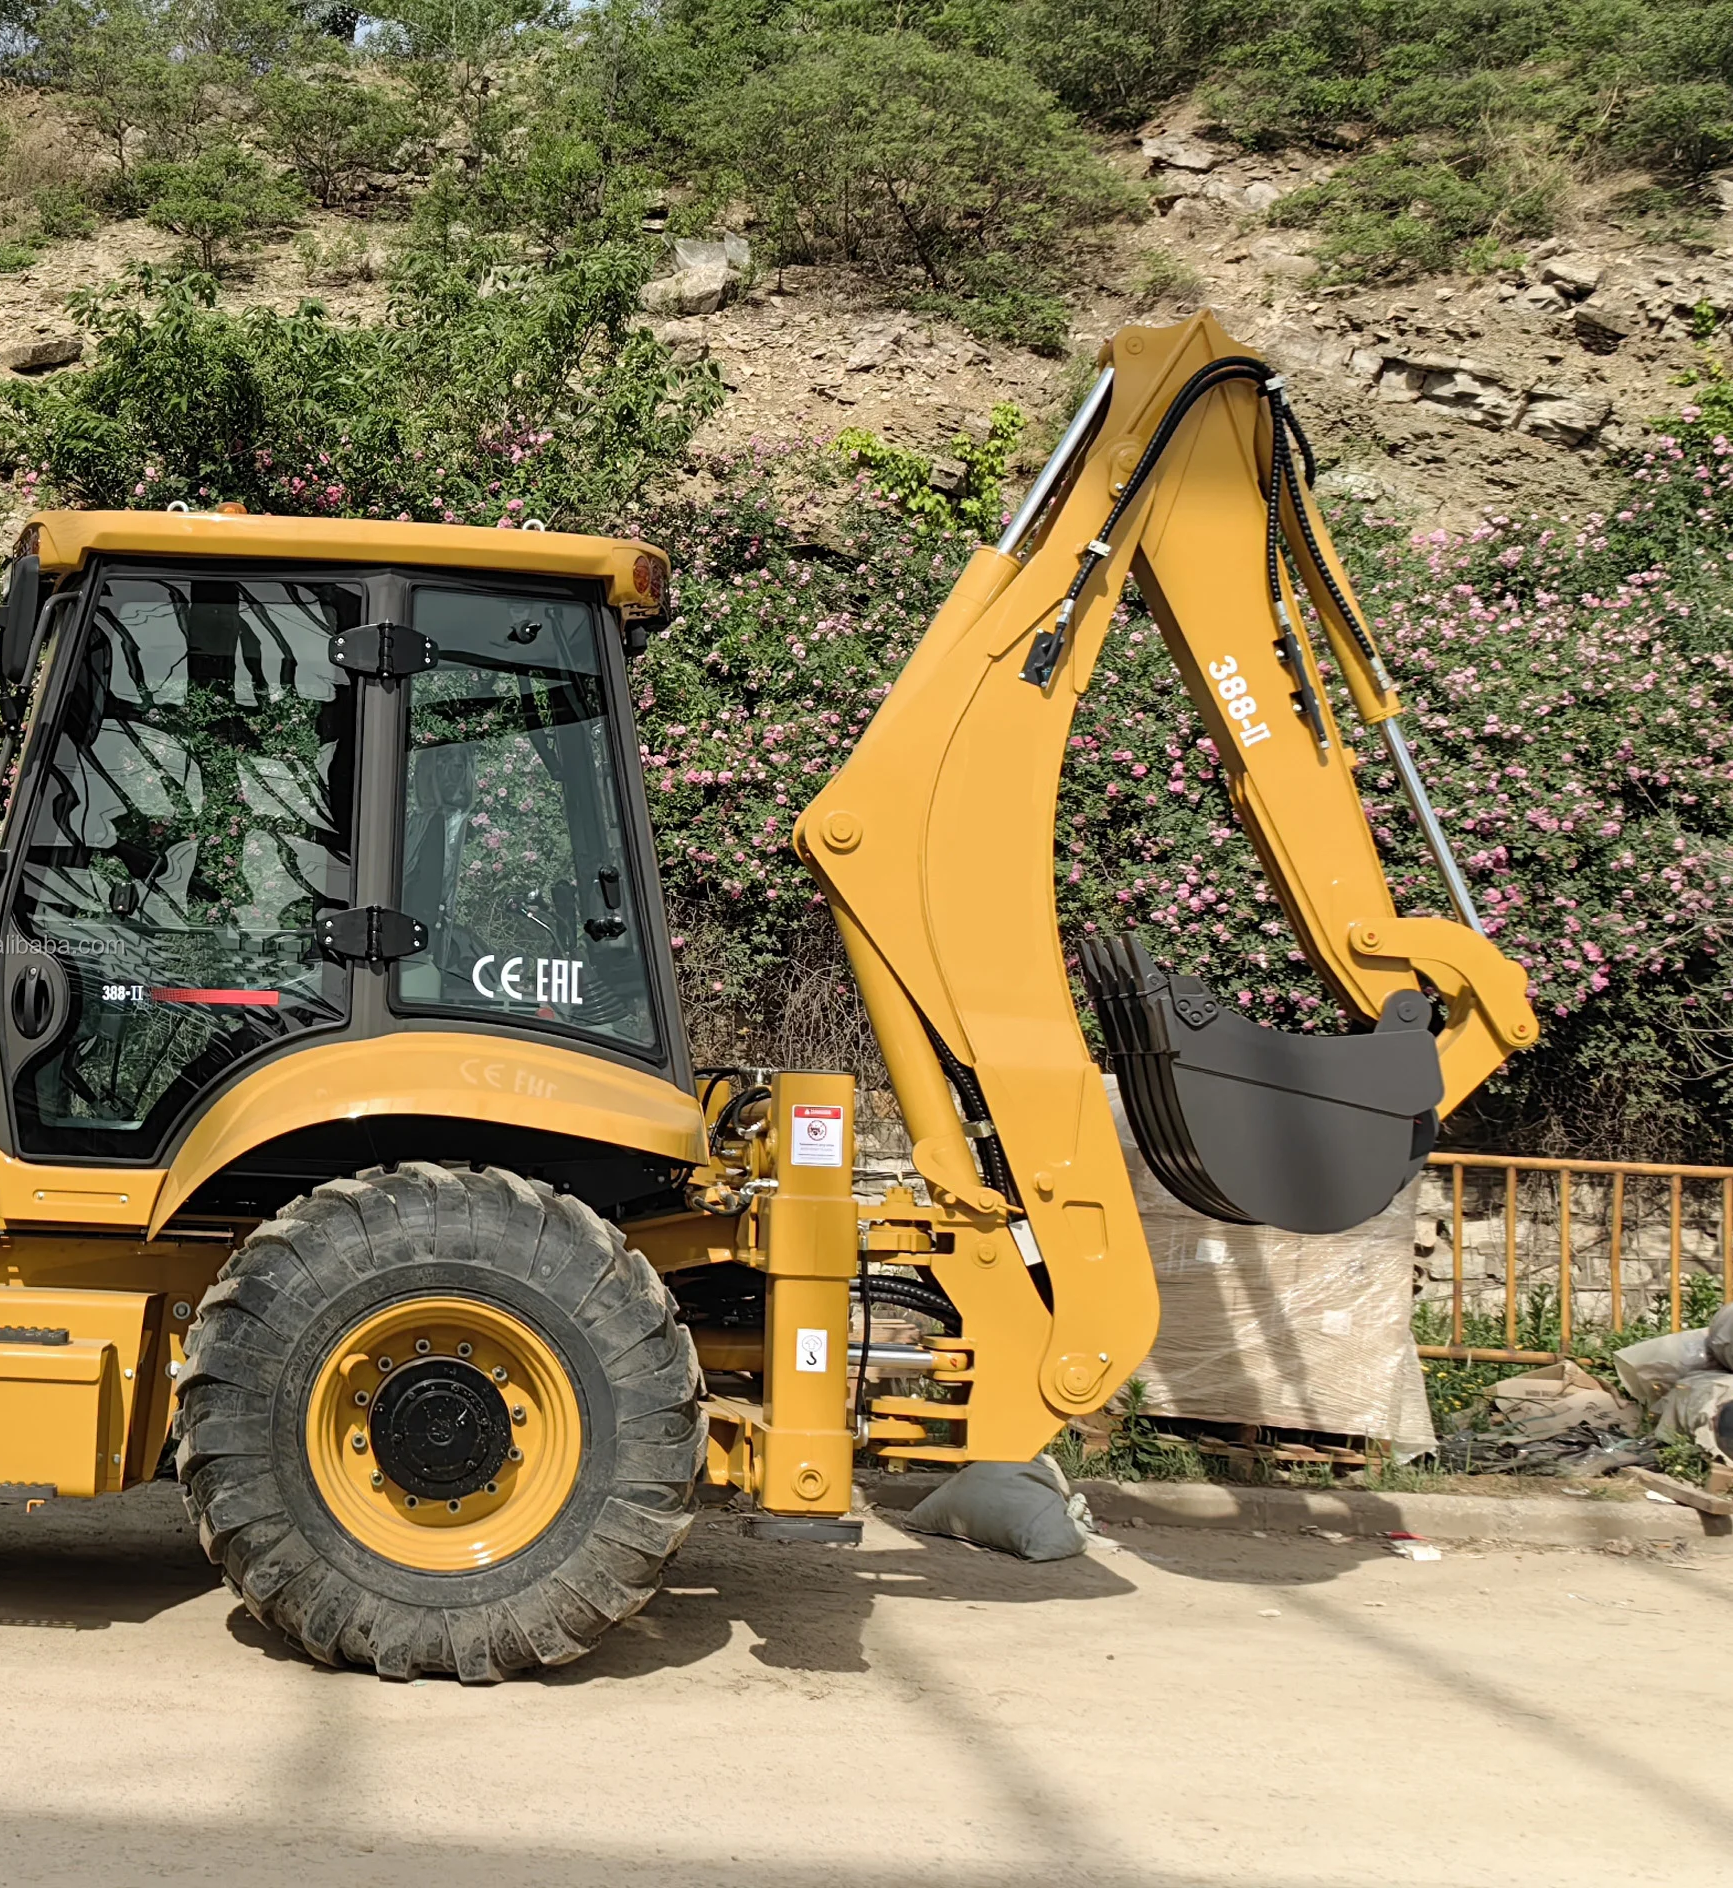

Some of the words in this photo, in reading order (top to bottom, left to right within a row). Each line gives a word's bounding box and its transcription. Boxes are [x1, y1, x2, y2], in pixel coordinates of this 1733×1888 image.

[1208, 655, 1272, 748] 388-II
[101, 985, 144, 1001] 388-II
[472, 954, 523, 1000] CE
